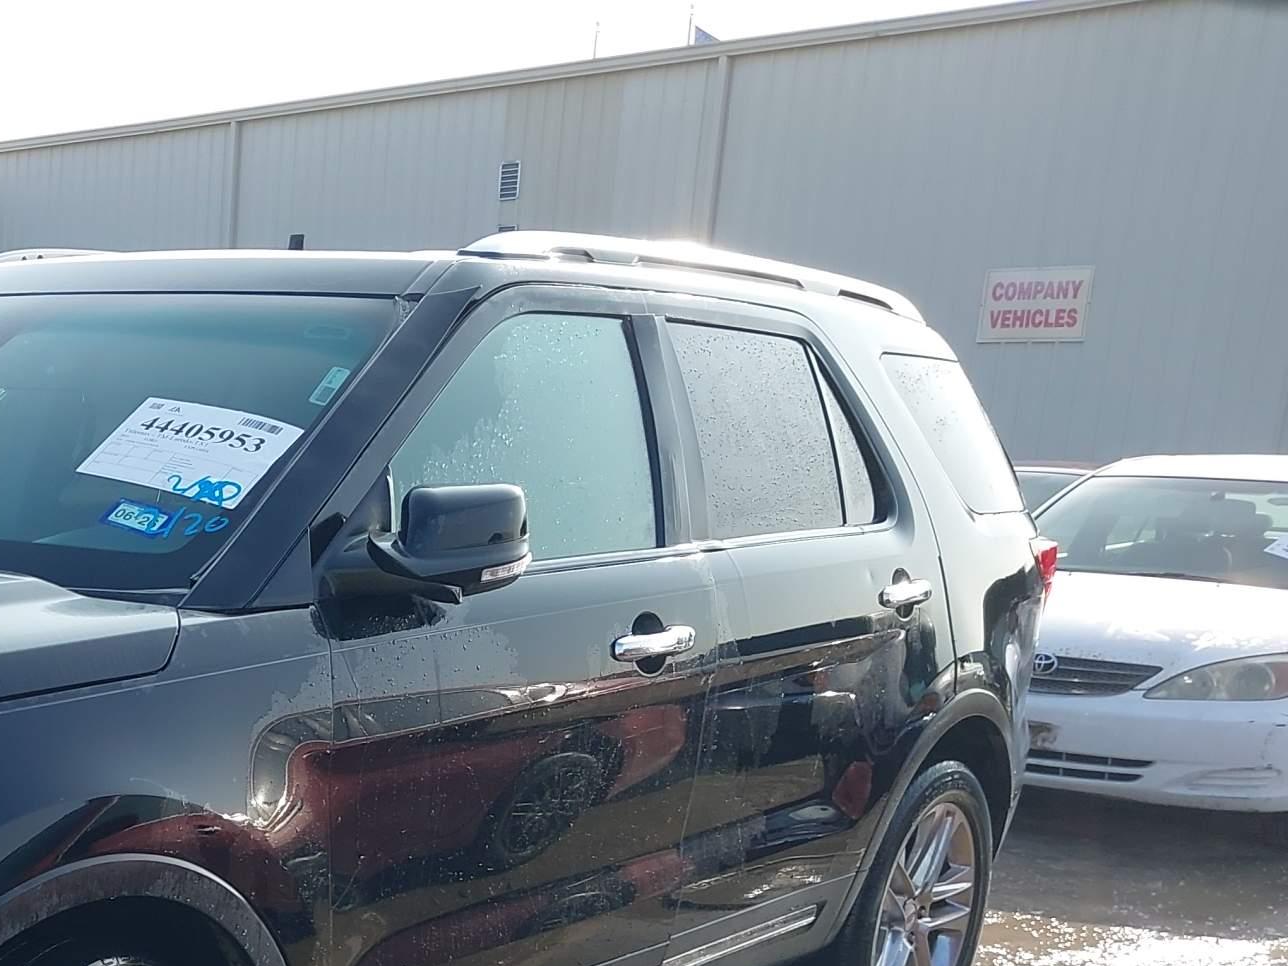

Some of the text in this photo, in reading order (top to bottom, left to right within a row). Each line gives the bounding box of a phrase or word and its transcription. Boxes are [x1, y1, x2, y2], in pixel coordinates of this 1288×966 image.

[991, 280, 1084, 301] COMPANY
[990, 308, 1078, 328] VEHICLES
[140, 416, 266, 452] 44405953
